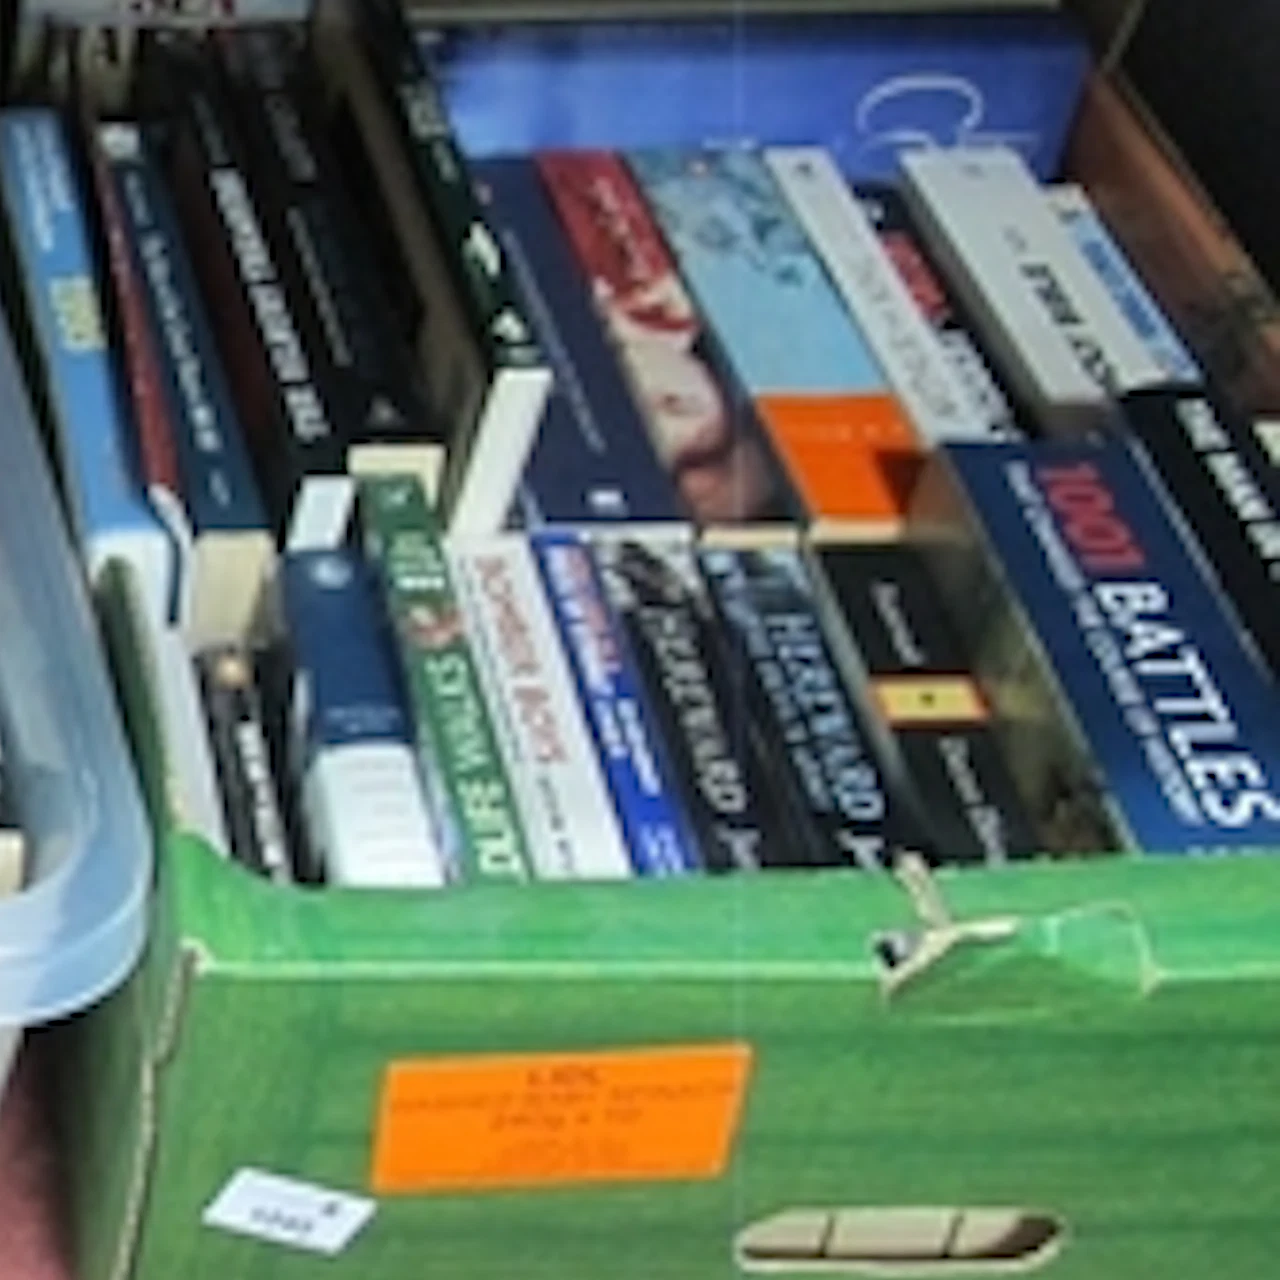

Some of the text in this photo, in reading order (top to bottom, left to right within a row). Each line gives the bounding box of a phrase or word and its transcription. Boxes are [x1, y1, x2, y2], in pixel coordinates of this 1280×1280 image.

[424, 650, 489, 773] WALKS
[765, 613, 884, 821] HEREWARD
[1037, 462, 1145, 570] 1001
[1096, 580, 1280, 830] BATTLES
